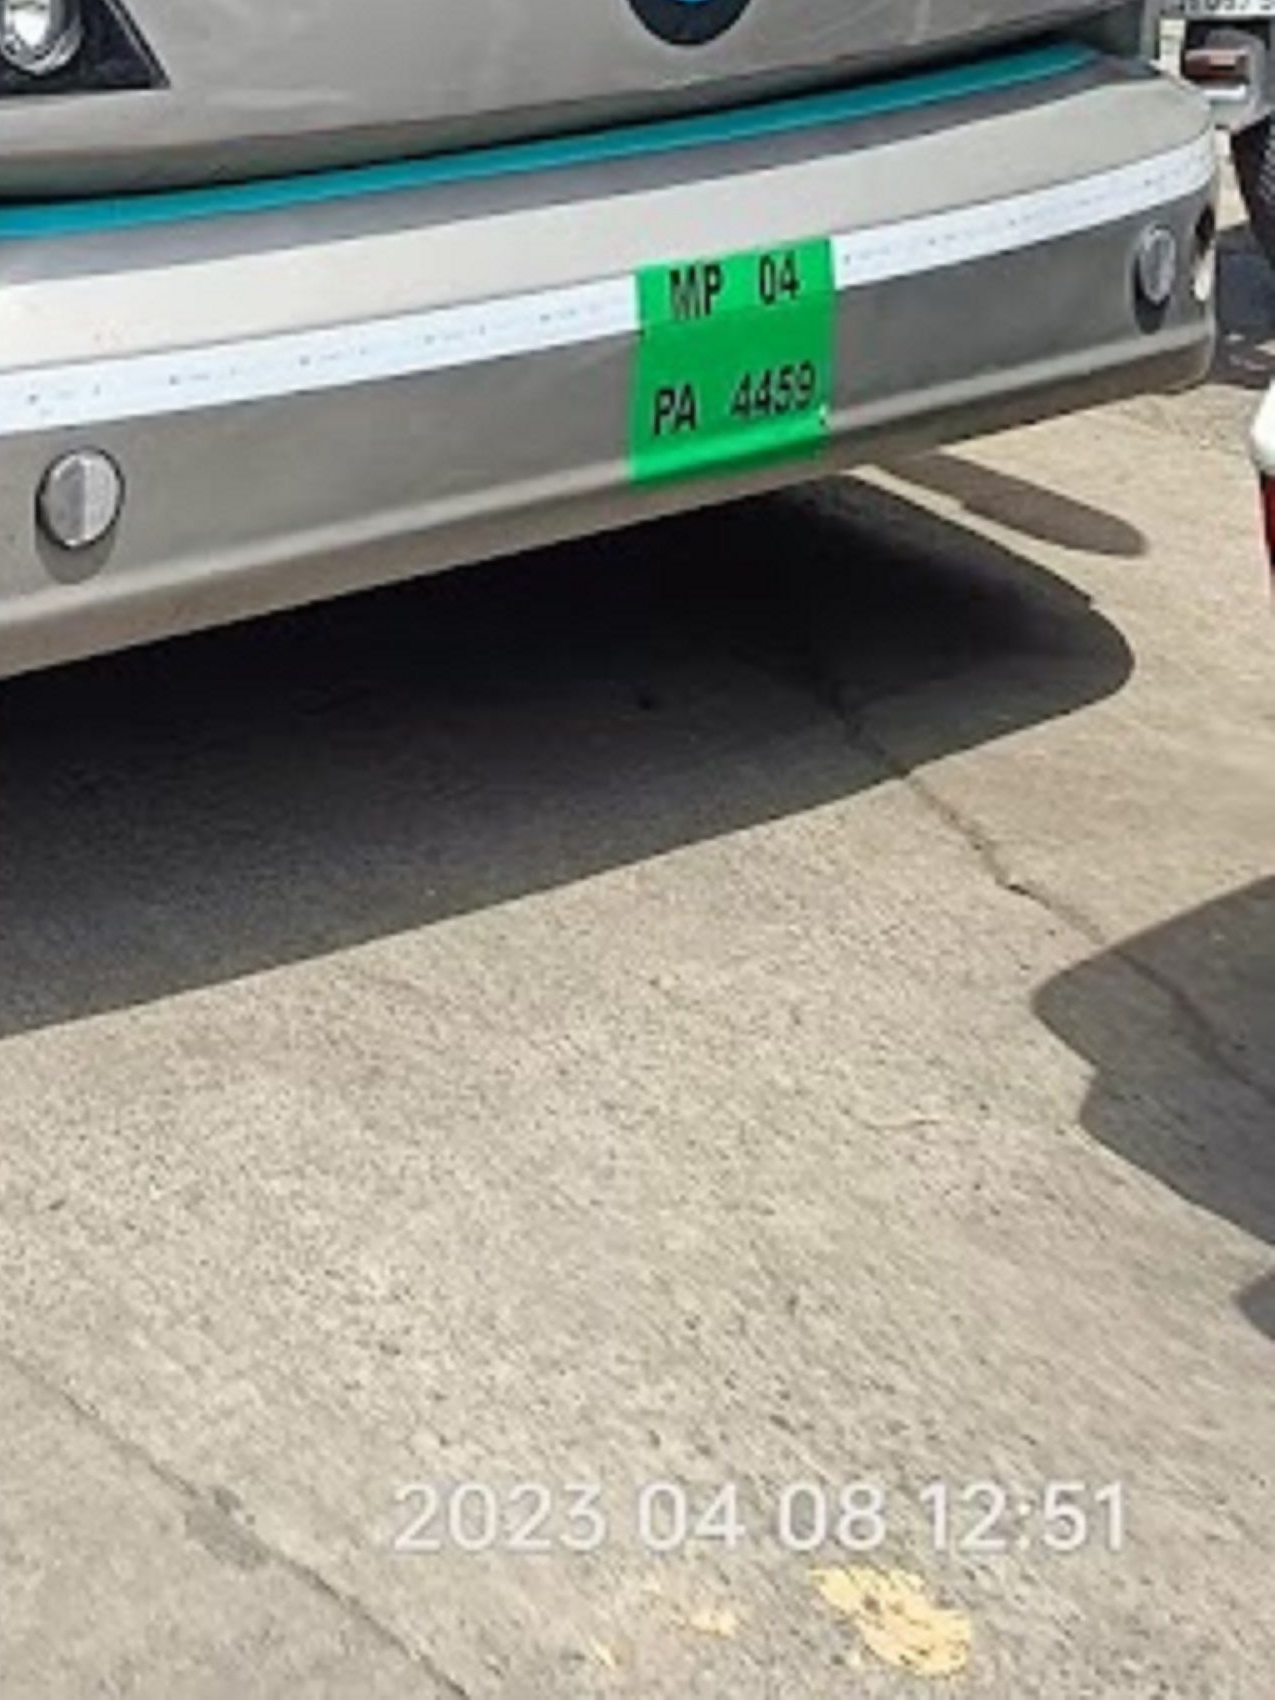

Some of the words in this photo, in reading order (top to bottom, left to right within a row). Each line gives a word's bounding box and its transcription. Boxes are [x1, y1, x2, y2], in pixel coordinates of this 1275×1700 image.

[670, 264, 725, 322] MP
[756, 252, 802, 306] 04
[653, 383, 698, 438] PA
[730, 360, 818, 420] 4459
